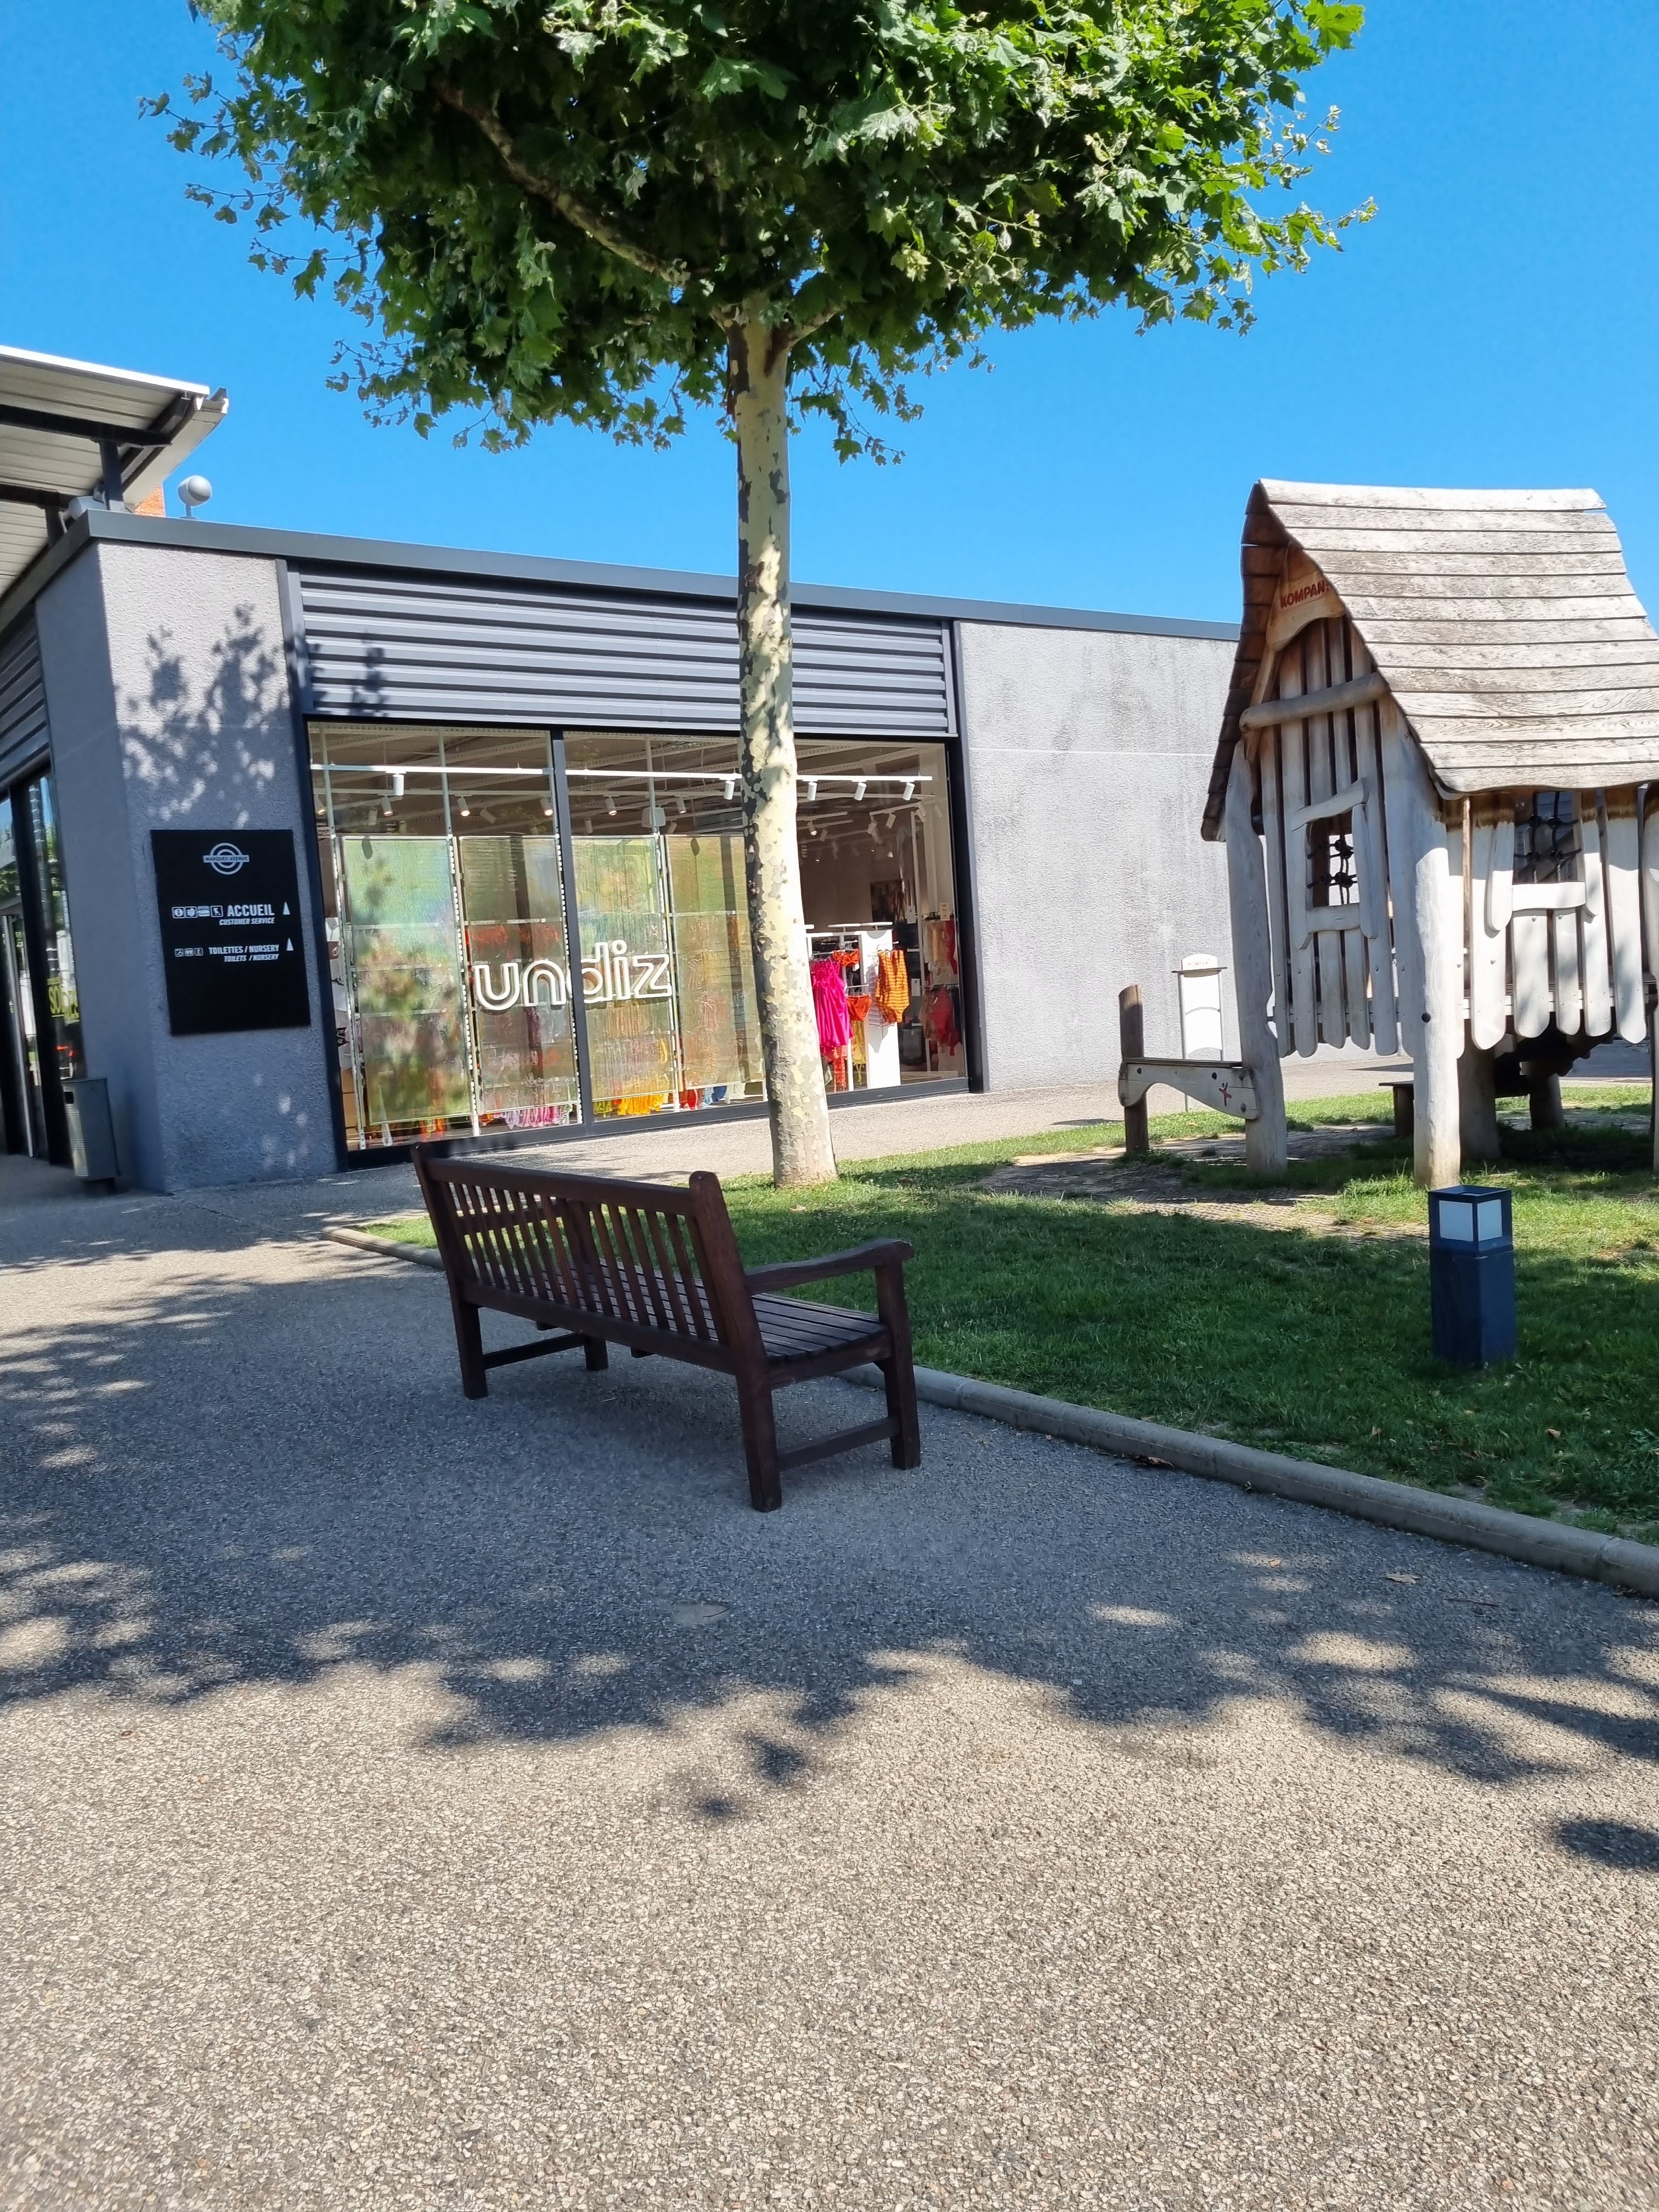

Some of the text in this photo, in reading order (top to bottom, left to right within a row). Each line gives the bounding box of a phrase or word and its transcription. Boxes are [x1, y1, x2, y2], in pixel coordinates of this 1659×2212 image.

[227, 904, 275, 917] ACCUEIL
[208, 946, 244, 955] TOILETTES
[249, 945, 279, 953] NURSERY
[473, 940, 672, 1011] undiz
